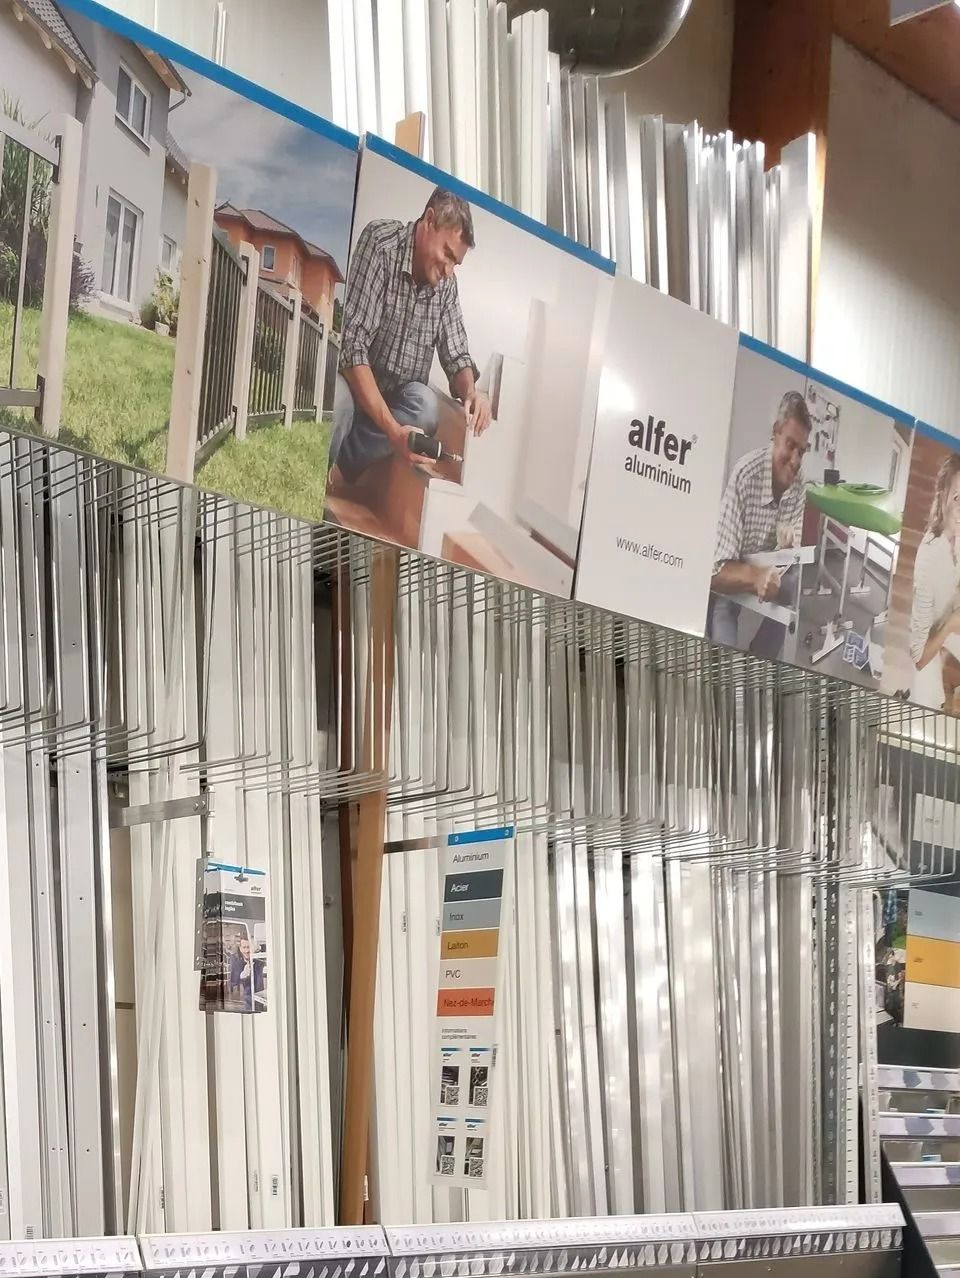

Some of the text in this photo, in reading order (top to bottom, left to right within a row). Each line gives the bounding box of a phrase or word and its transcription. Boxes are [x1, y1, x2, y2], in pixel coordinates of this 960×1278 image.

[624, 454, 691, 494] aluminium
[616, 536, 683, 568] www.alfer.com
[452, 852, 490, 863] Aluminium
[450, 883, 470, 893] Acier
[449, 913, 464, 921] Inox
[447, 941, 469, 950] Laiton
[445, 969, 461, 979] PVC
